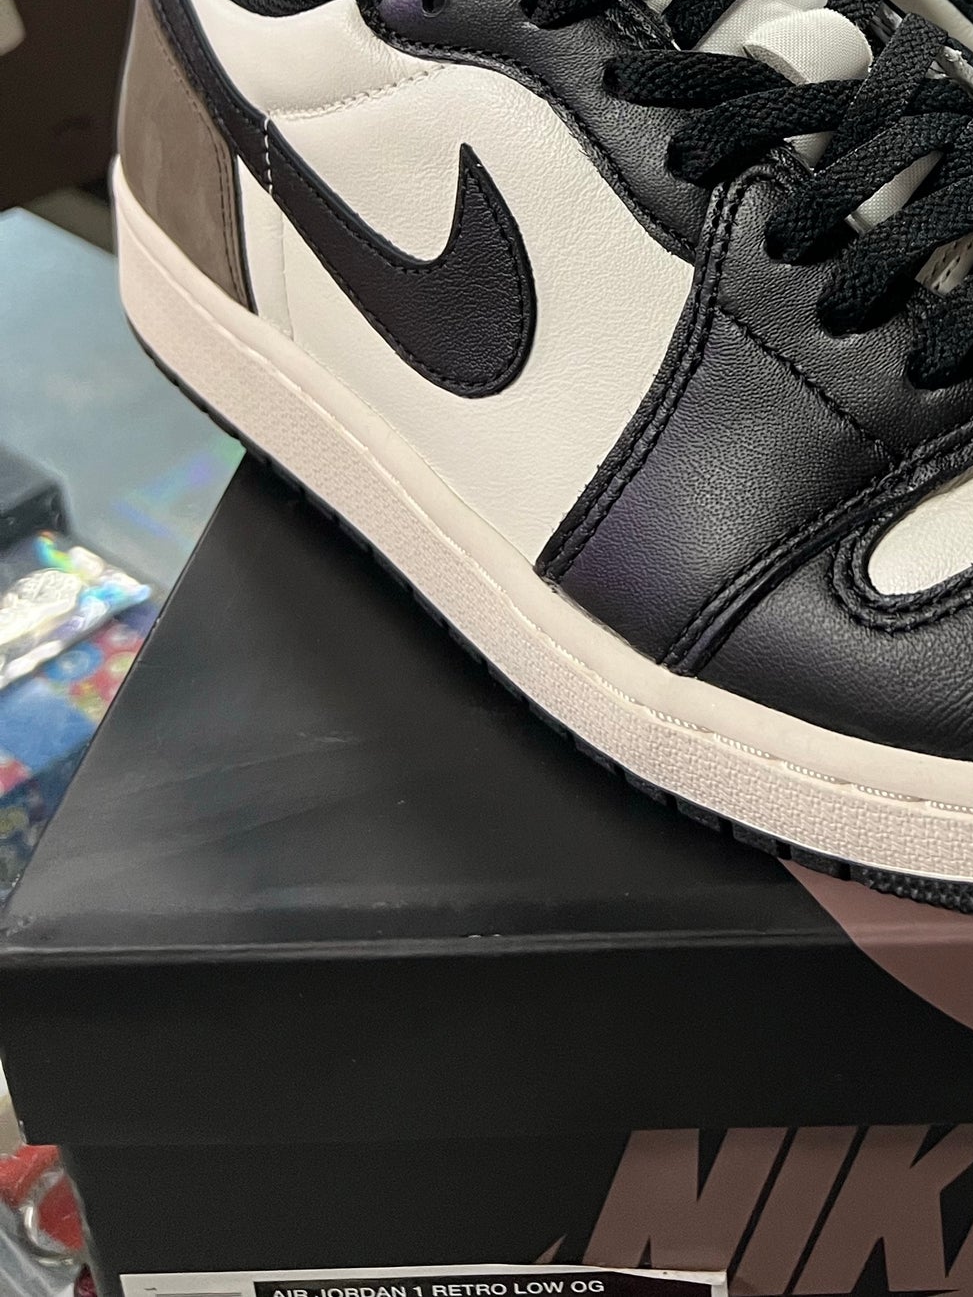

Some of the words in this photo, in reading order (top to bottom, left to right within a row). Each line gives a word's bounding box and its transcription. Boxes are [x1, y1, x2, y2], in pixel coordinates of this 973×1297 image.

[412, 1286, 424, 1297] 1
[431, 1283, 507, 1297] RETRO
[513, 1281, 564, 1295] LOW
[570, 1280, 605, 1293] OG
